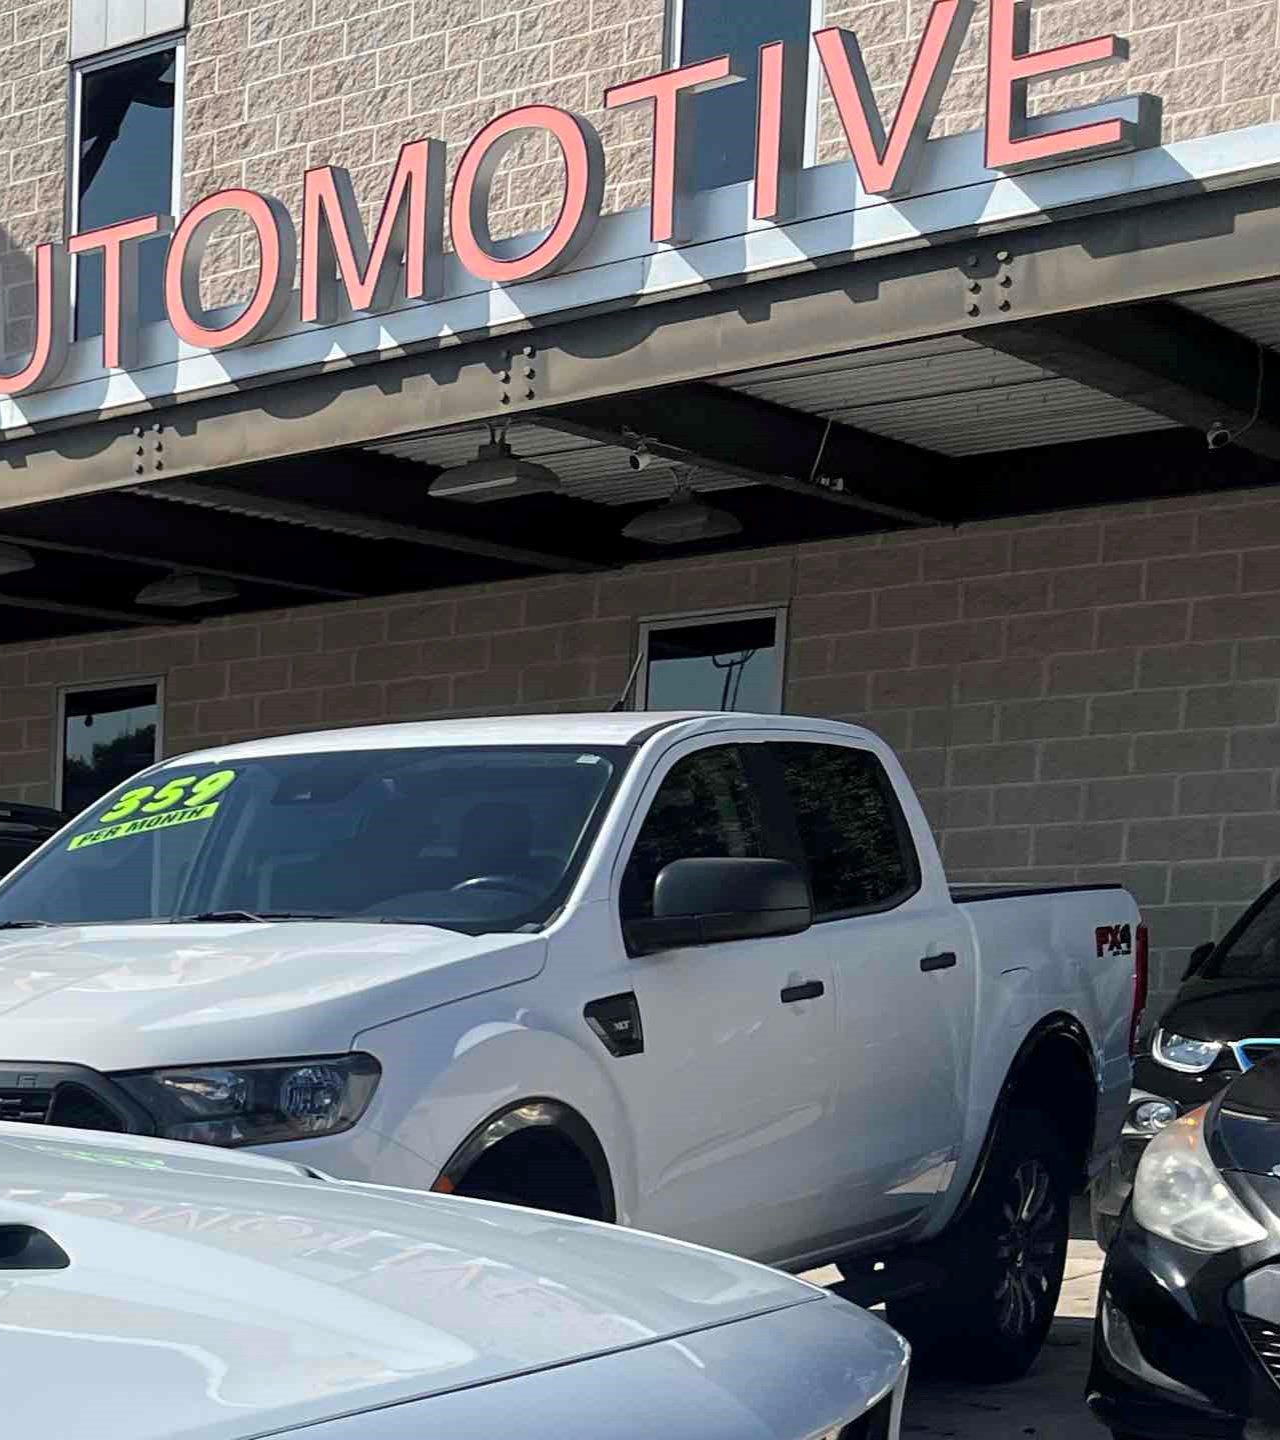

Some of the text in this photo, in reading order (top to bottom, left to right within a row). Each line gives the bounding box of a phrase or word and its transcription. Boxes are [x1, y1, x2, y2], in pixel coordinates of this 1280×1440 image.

[99, 769, 236, 823] 359
[77, 806, 206, 847] PER MONTH
[1094, 923, 1132, 958] FX4
